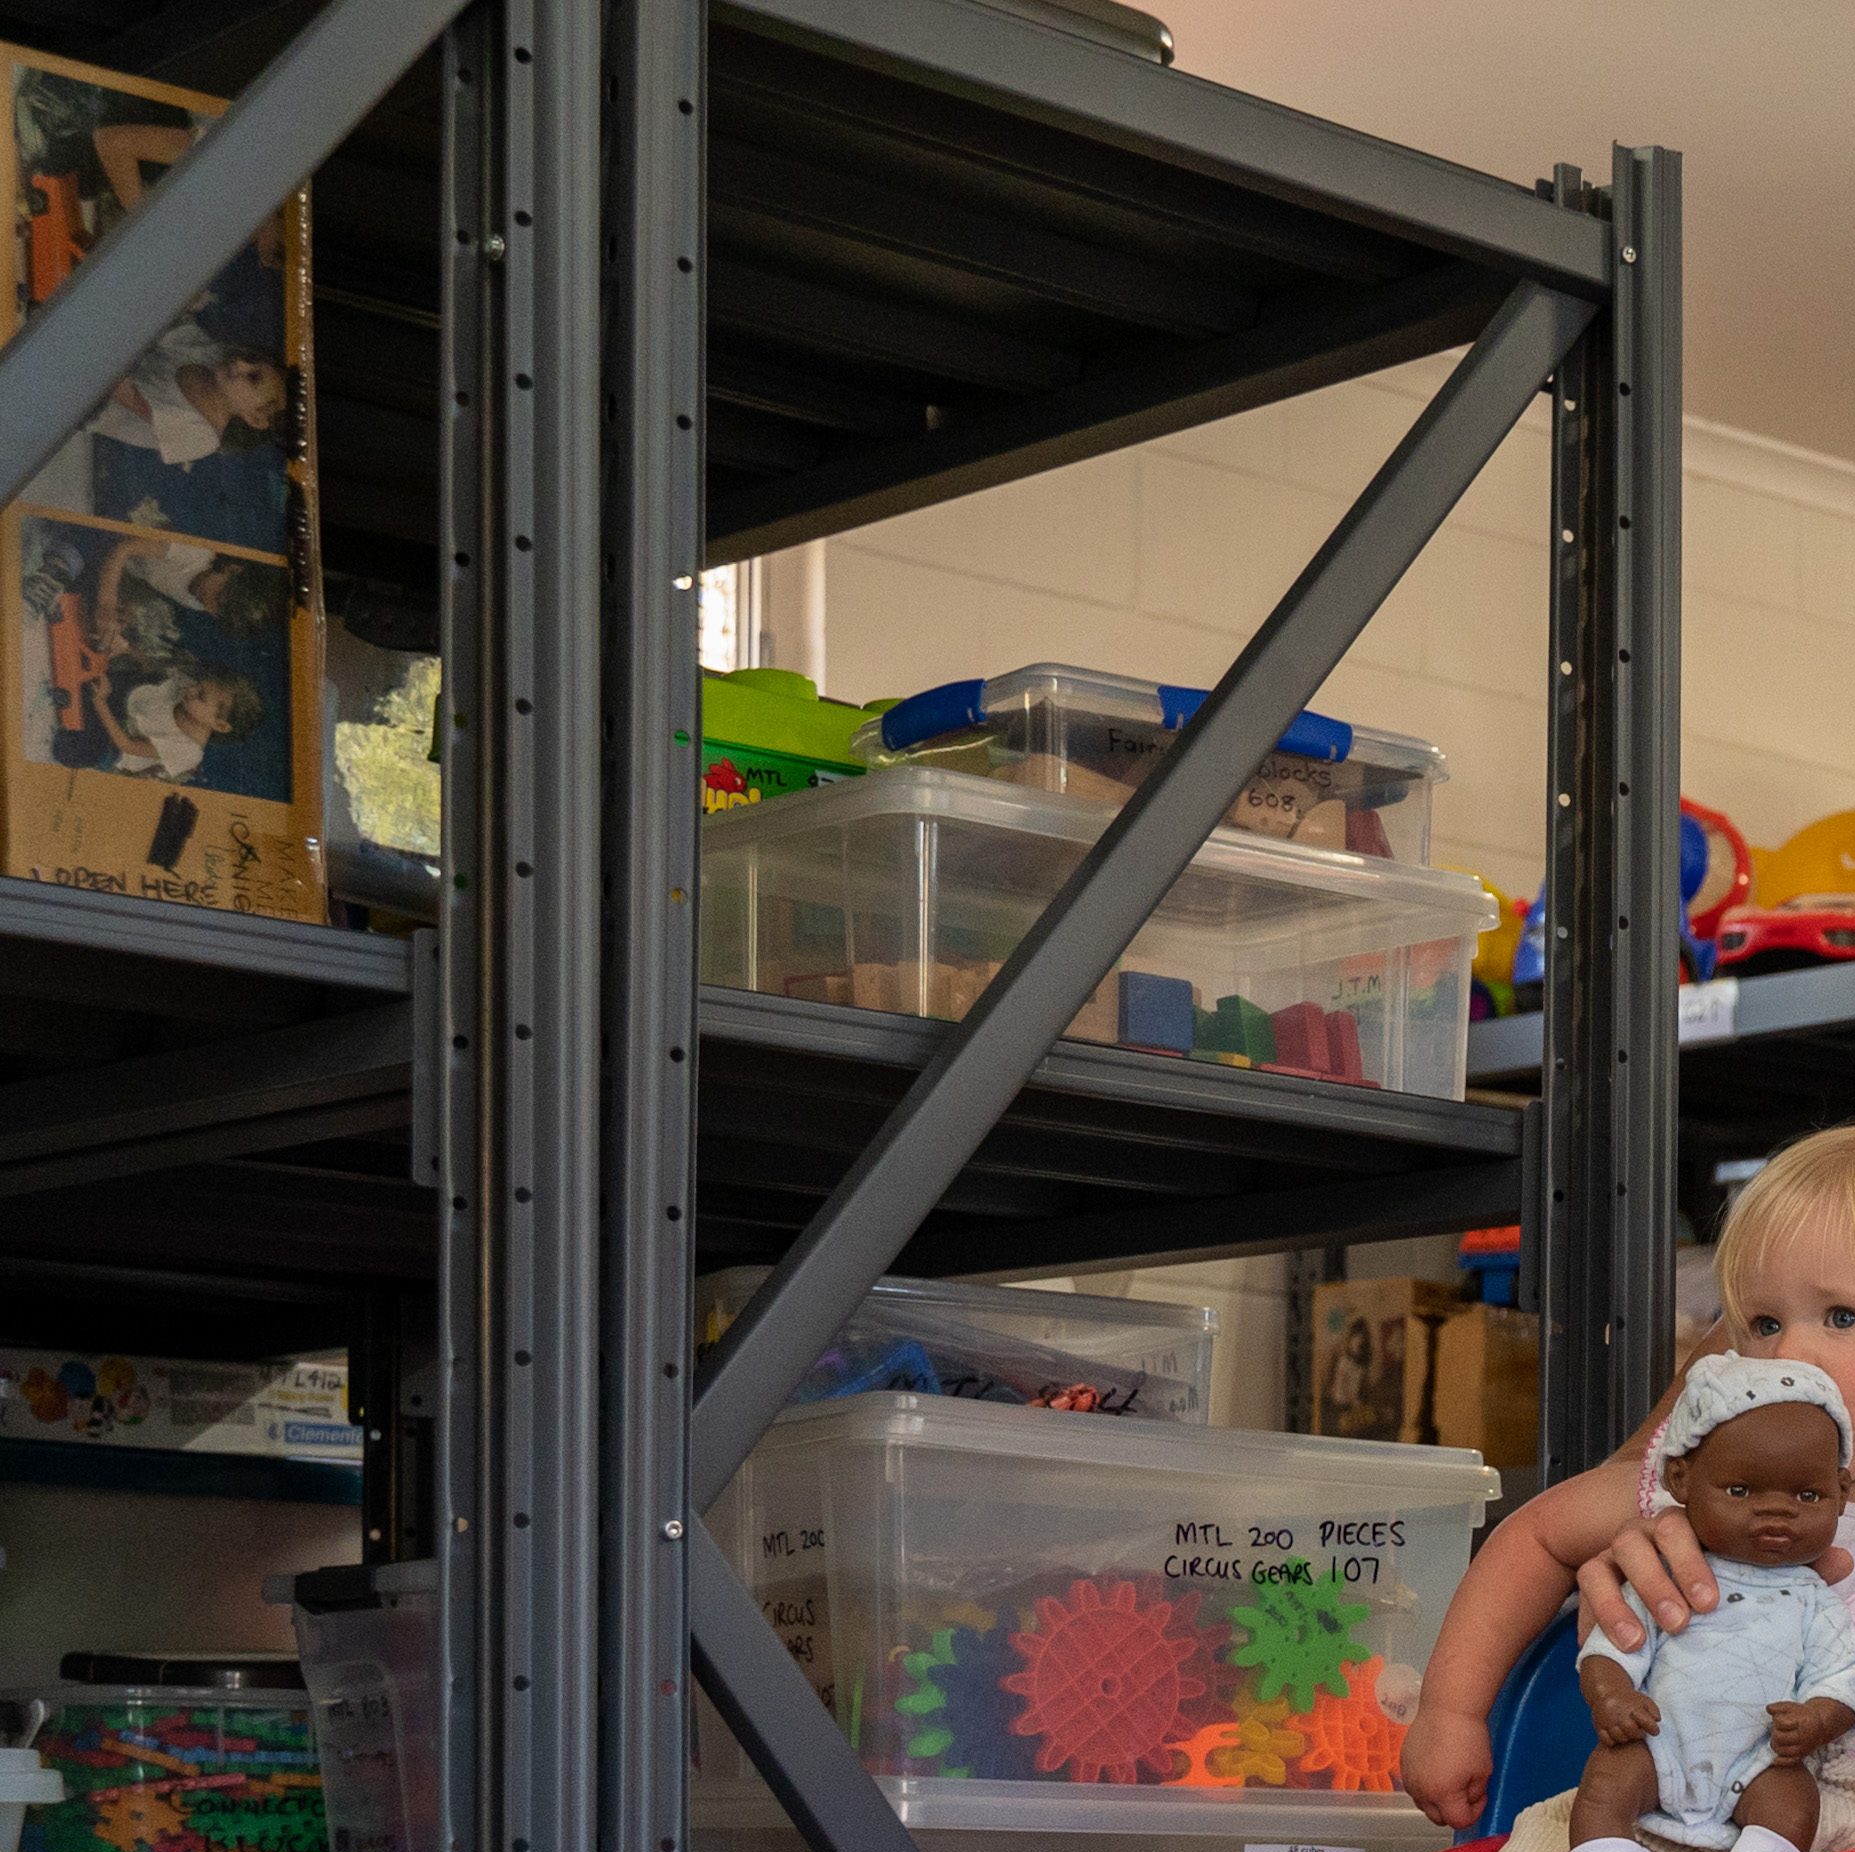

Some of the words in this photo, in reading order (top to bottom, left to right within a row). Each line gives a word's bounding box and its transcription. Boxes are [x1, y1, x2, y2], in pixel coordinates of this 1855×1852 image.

[746, 767, 788, 787] MTL
[55, 866, 127, 892] OPEN
[762, 1531, 796, 1558] MTL
[1175, 1522, 1233, 1547] MTL
[1248, 1526, 1294, 1551] 200
[1319, 1520, 1406, 1548] PIECES
[1163, 1554, 1243, 1580] CIRCUS
[1250, 1560, 1314, 1586] GEARS
[1331, 1555, 1381, 1585] 107
